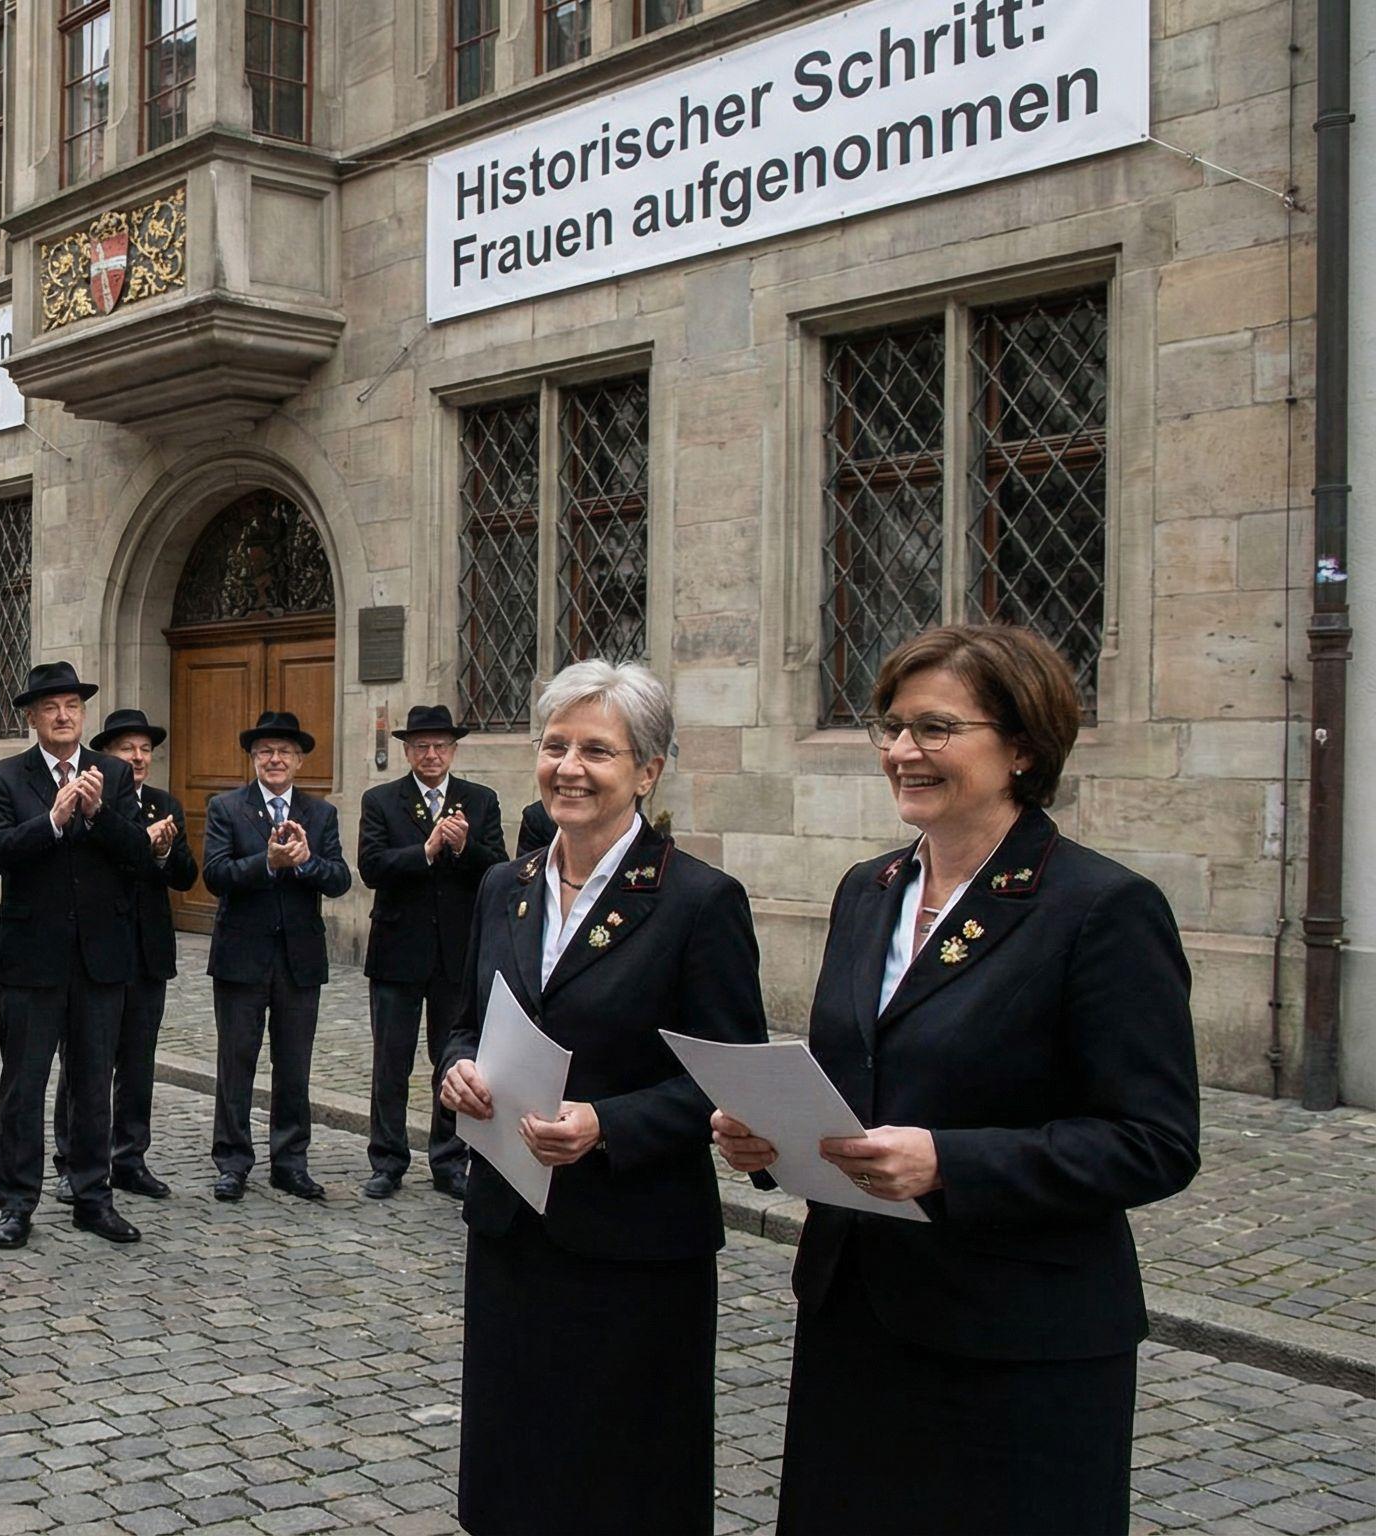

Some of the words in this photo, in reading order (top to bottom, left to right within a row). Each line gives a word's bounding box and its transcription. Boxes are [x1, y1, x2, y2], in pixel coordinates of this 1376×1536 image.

[453, 207, 613, 288] Frauen
[632, 67, 1099, 238] aufgenommen
[457, 82, 774, 221] Historischer
[792, 0, 1045, 113] Schritt:
